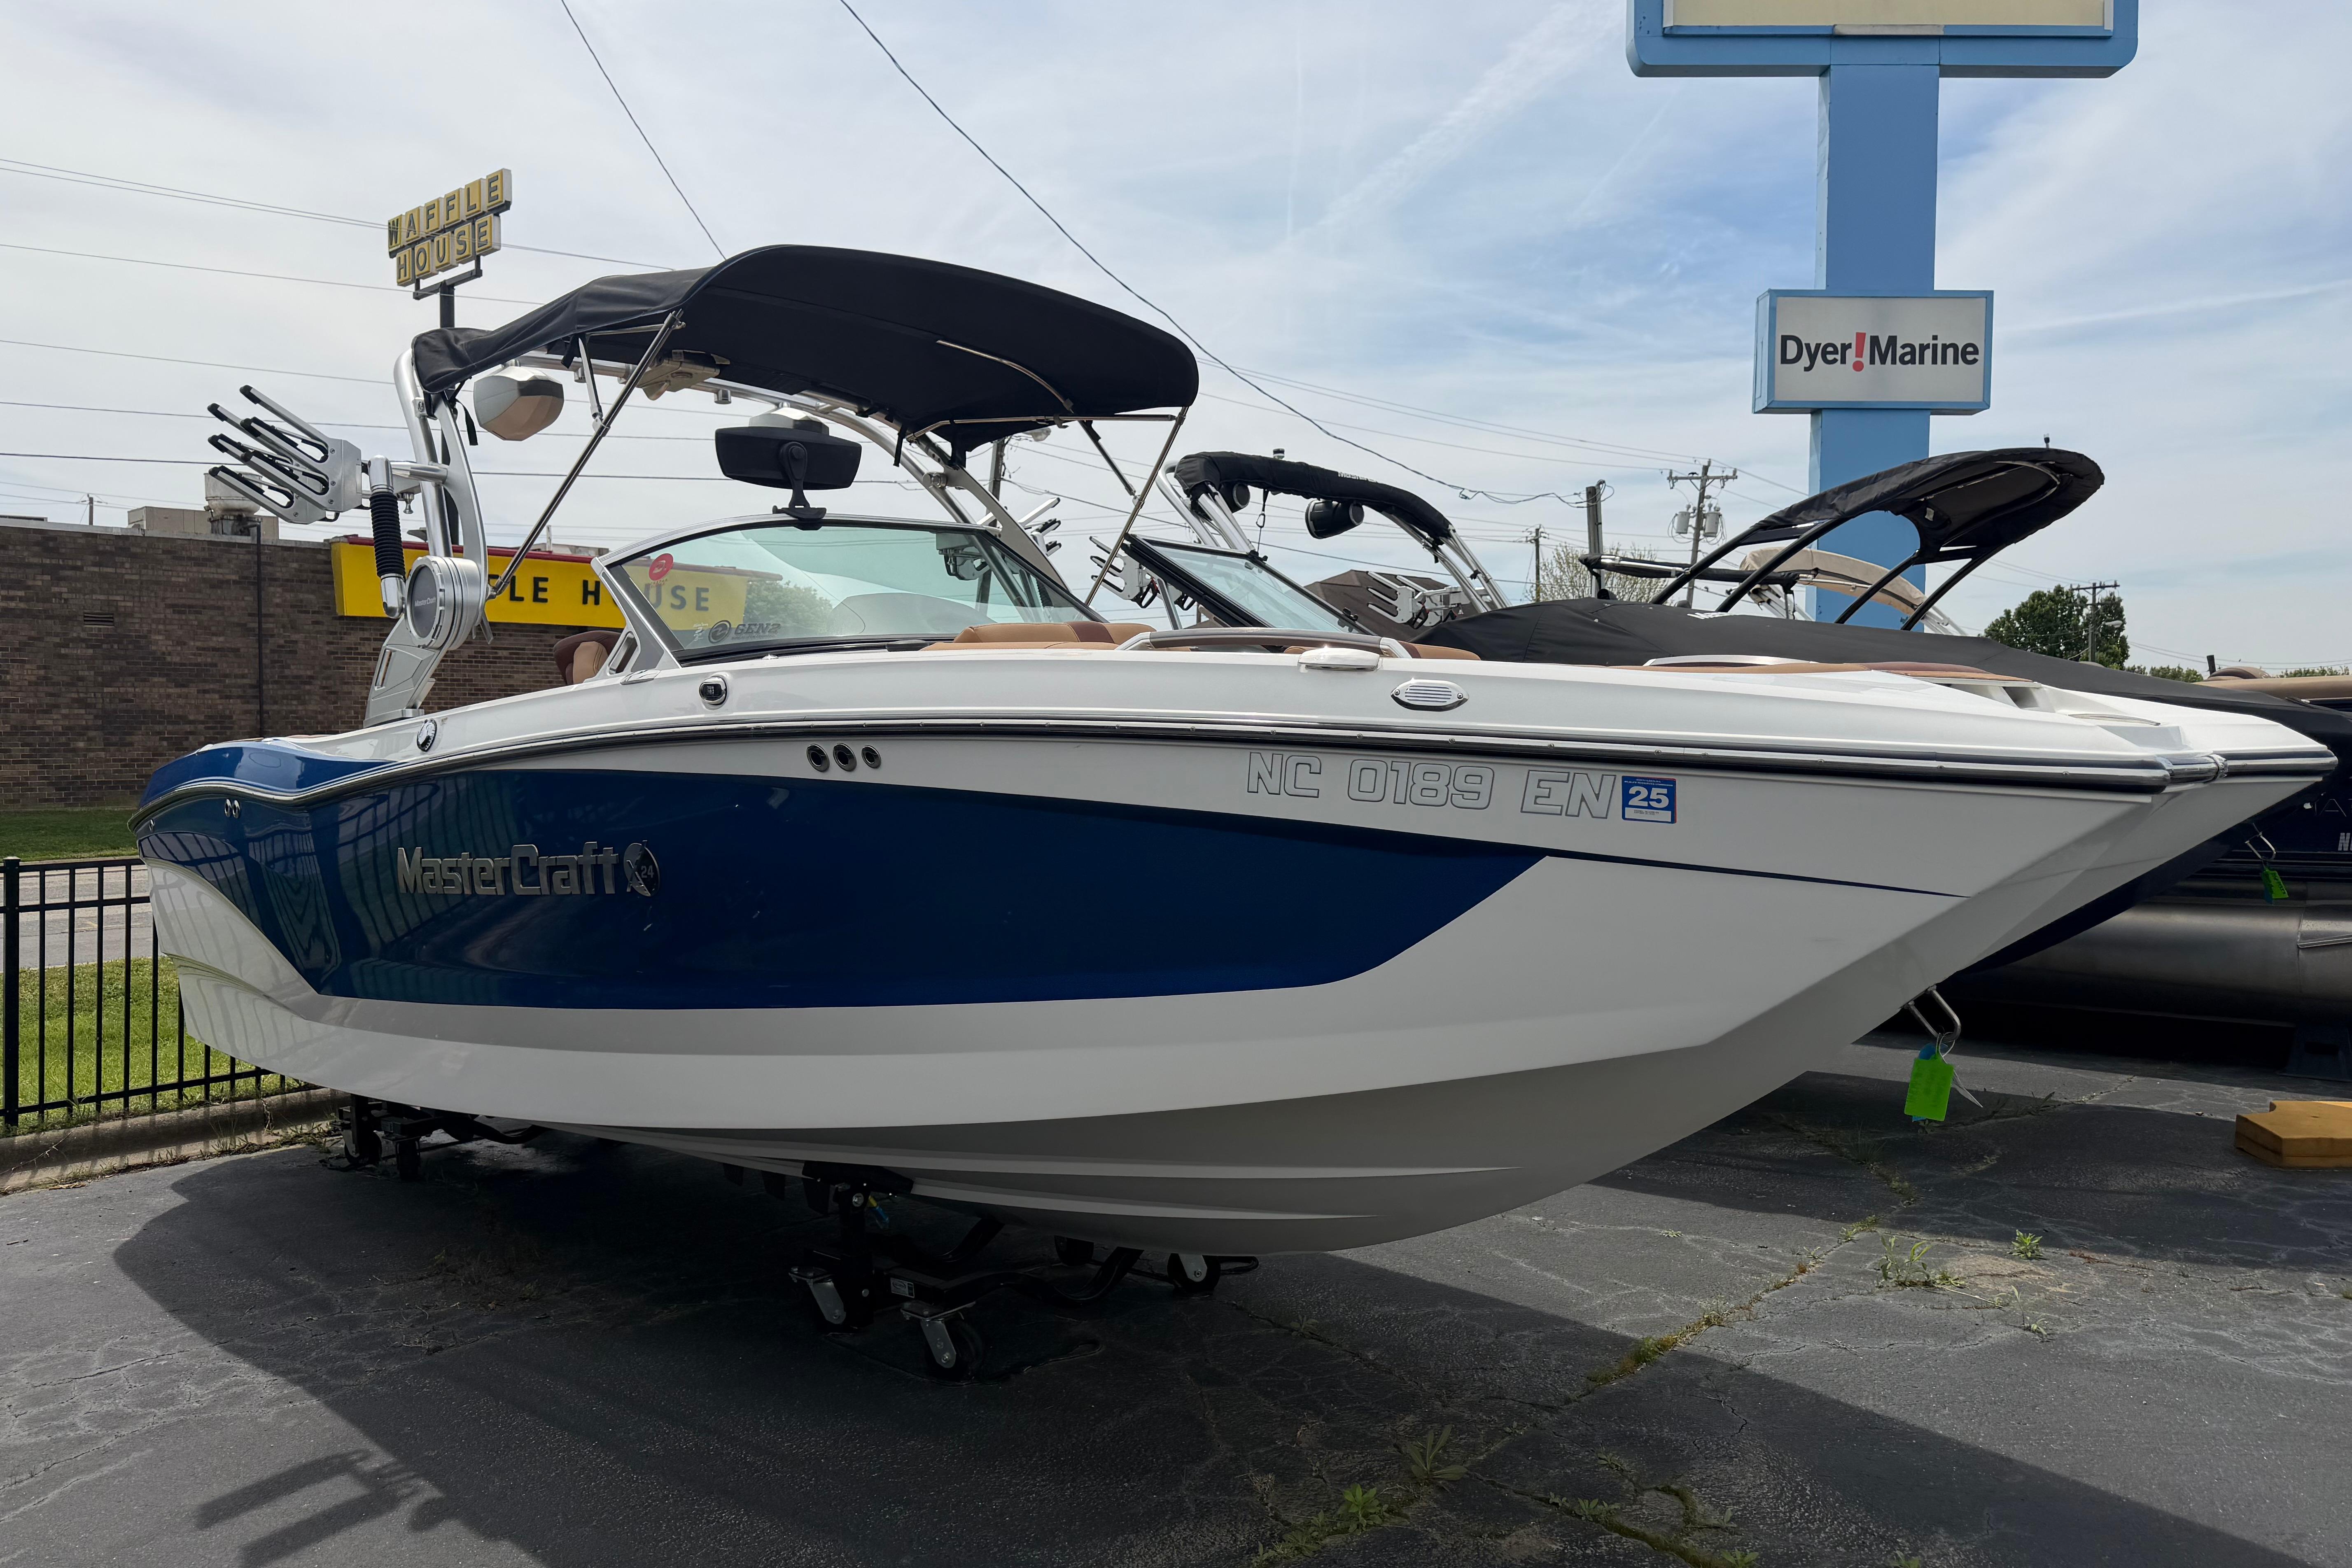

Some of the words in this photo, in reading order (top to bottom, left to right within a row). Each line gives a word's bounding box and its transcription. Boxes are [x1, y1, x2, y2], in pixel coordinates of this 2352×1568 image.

[388, 175, 499, 246] WAFFLE
[398, 220, 488, 280] HOUSE
[582, 580, 709, 611] HUSE
[1248, 751, 1321, 798] NC
[1348, 759, 1495, 810] 0189
[1520, 769, 1617, 819] EN
[1628, 786, 1669, 808] 25
[397, 841, 618, 895] MasterCraft
